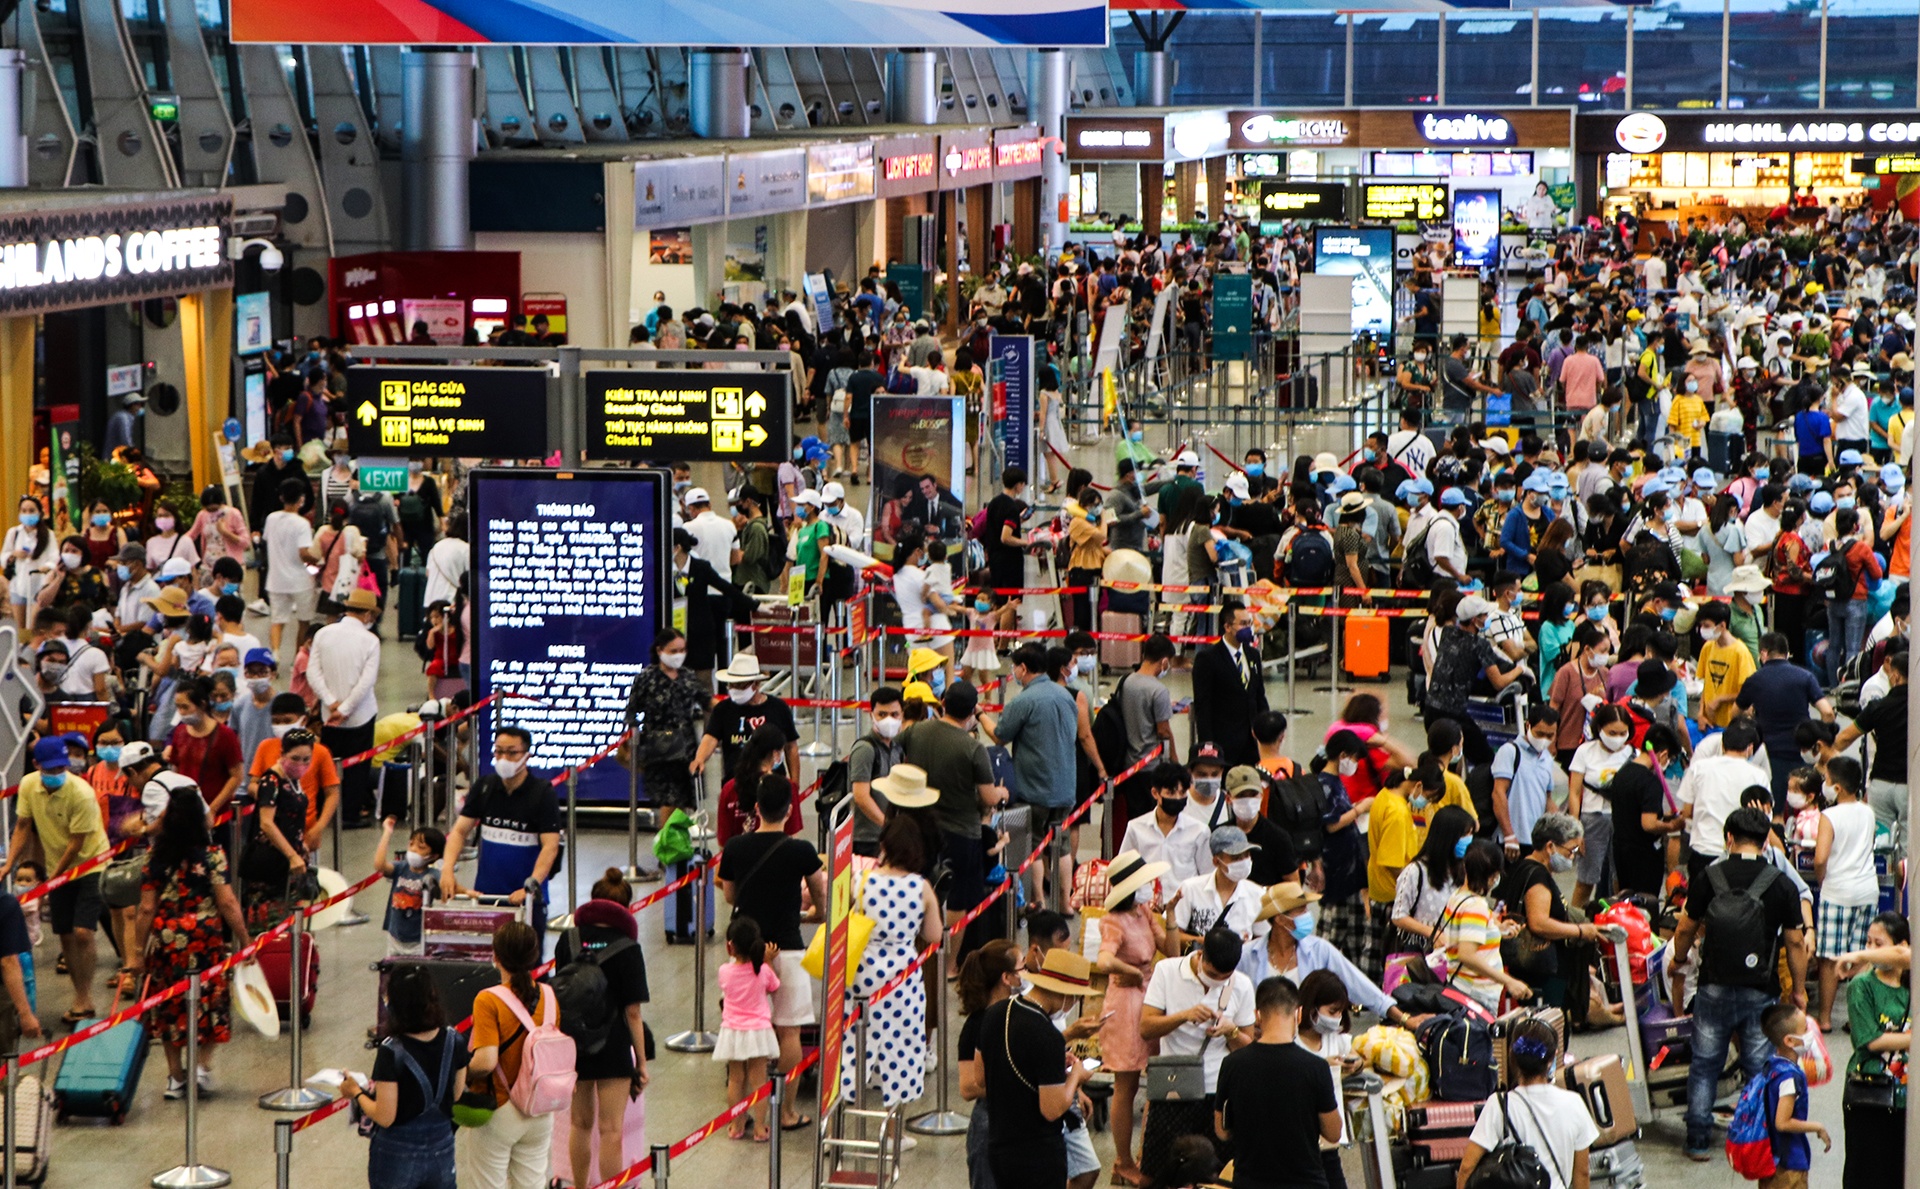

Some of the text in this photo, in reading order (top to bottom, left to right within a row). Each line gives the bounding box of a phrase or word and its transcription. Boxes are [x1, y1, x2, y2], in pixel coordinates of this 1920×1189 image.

[1423, 113, 1508, 140] tealive
[1704, 122, 1863, 142] HIGHLANDS
[885, 153, 933, 180] LUCKY GIFT SHOP
[126, 226, 220, 274] COFFEE
[412, 380, 437, 395] CÁC
[412, 395, 462, 408] All Gates
[636, 389, 659, 402] TRA
[659, 389, 677, 402] AN
[679, 390, 707, 403] NINH
[604, 402, 685, 417] Security Check
[412, 417, 438, 431] NHÀ
[457, 418, 485, 432] SINH
[412, 432, 449, 445] Toilets
[605, 434, 639, 446] Check
[372, 471, 403, 488] EXIT
[548, 645, 585, 658] NOTICE
[486, 816, 528, 830] TOMMY
[481, 828, 530, 842] HILFIGER
[452, 917, 495, 926] AGRIBANK
